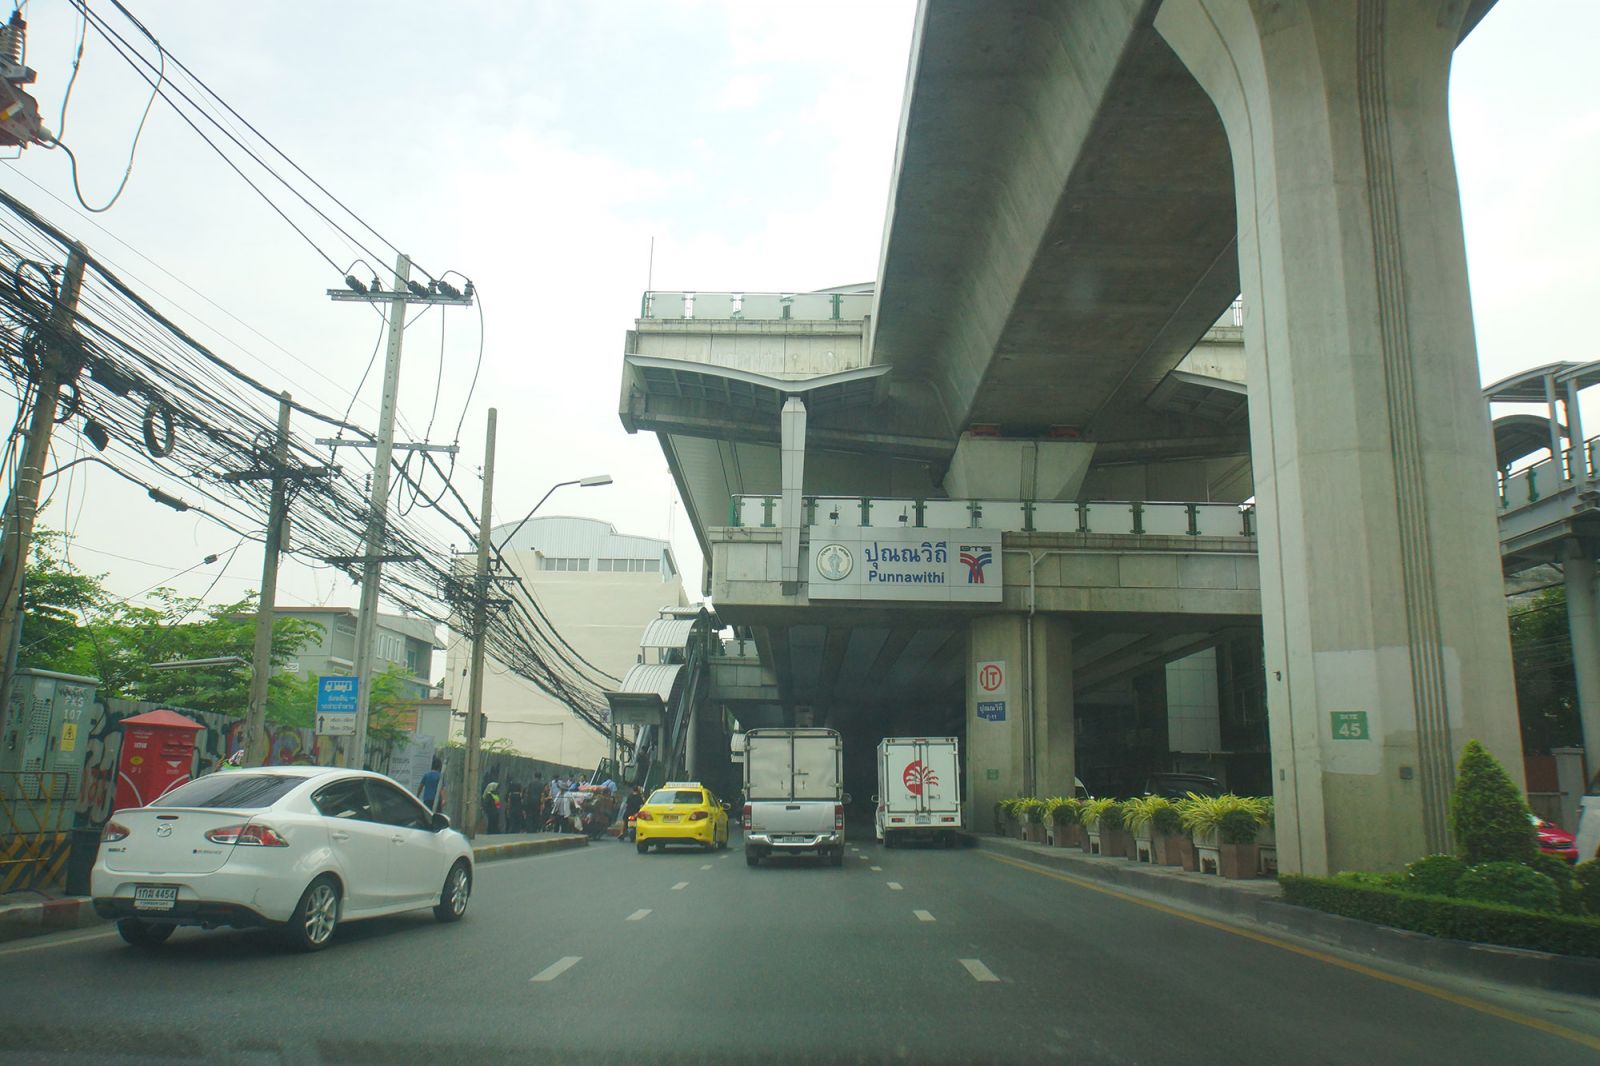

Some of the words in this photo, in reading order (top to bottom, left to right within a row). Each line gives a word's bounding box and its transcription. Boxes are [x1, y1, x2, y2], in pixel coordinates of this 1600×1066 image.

[865, 541, 947, 570] ปุณณวิถี
[868, 570, 945, 584] Punnawithi
[63, 709, 82, 720] 107
[1339, 722, 1361, 737] 45
[155, 889, 175, 898] 4454
